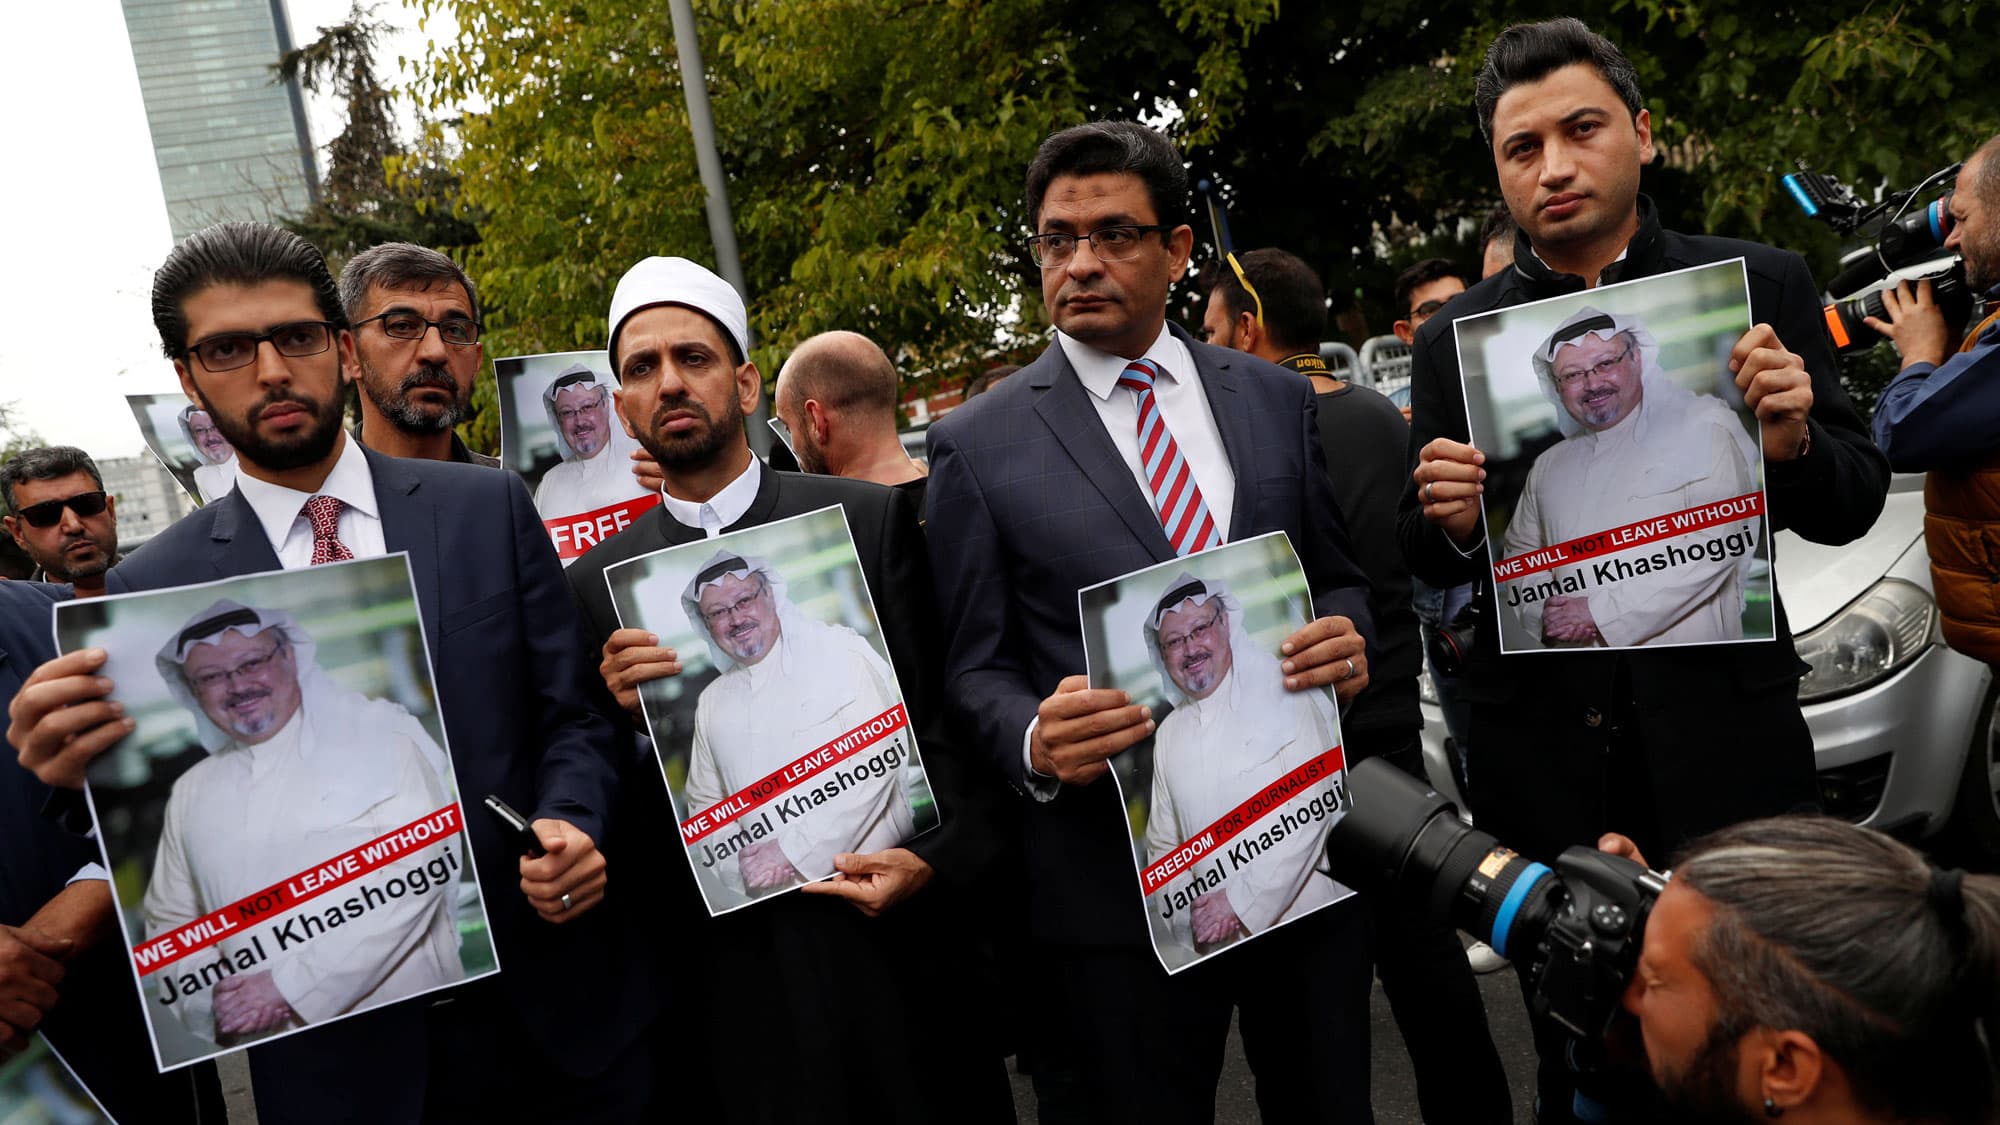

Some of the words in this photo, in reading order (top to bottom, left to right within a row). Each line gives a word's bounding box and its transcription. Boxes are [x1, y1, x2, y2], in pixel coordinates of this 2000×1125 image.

[550, 508, 631, 552] FREE
[1494, 560, 1523, 576] WE
[1524, 548, 1568, 568] WILL
[1570, 536, 1606, 556] NOT
[1610, 519, 1669, 546] LEAVE
[1672, 496, 1758, 529] WITHOUT
[1507, 568, 1586, 607] Jamal
[1593, 526, 1754, 586] Khashoggi
[682, 816, 711, 838] WE
[710, 796, 750, 823] WILL
[750, 776, 782, 801] NOT
[784, 748, 834, 783] LEAVE
[832, 709, 902, 755] WITHOUT
[702, 812, 774, 868] Jamal
[774, 738, 906, 824] Khashoggi
[1146, 832, 1215, 888] FREEDOM
[1215, 814, 1243, 840] FOR
[1245, 760, 1327, 819] JOURNALIST
[134, 938, 177, 968] WE
[176, 914, 238, 948] WILL
[238, 888, 284, 921] NOT
[288, 854, 360, 898] LEAVE
[360, 810, 456, 864] WITHOUT
[1162, 858, 1227, 919] Jamal
[1228, 780, 1344, 871] Khashoggi
[159, 936, 268, 1006] Jamal
[272, 846, 458, 951] Khashoggi
